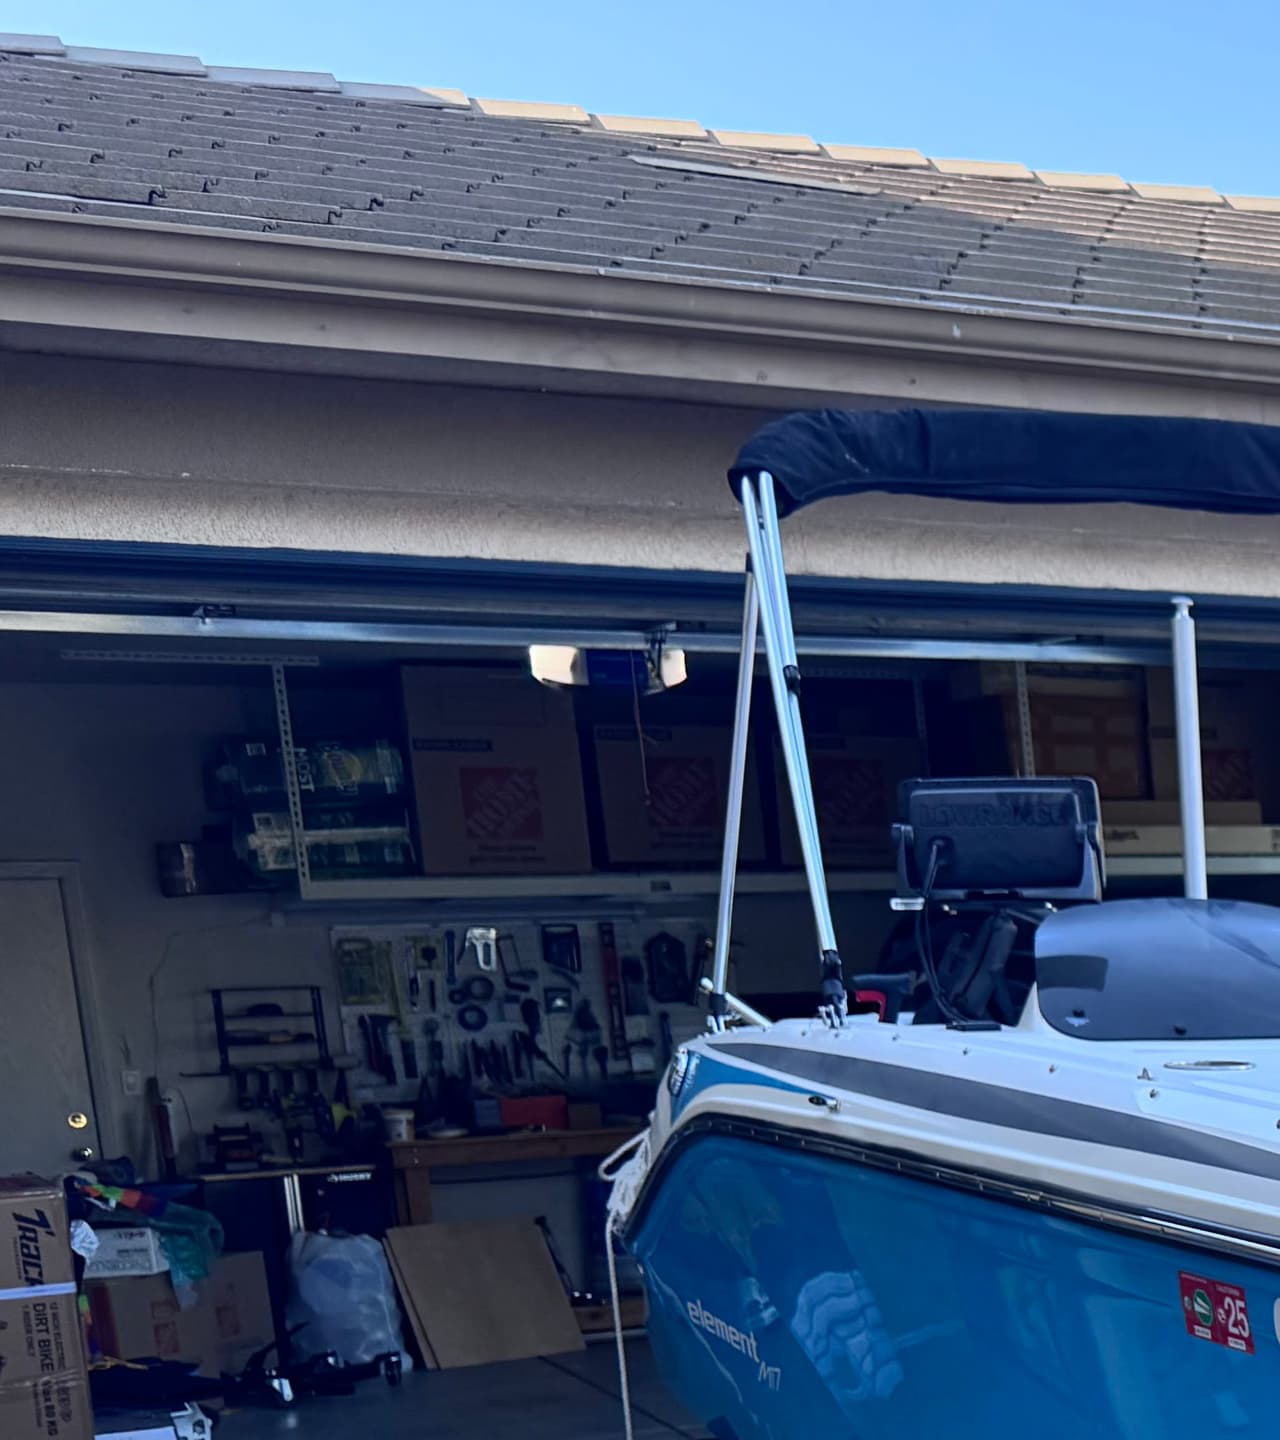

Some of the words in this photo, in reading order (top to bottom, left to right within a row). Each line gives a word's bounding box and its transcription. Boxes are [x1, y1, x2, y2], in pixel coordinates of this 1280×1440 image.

[33, 1303, 49, 1335] DIRT
[686, 1298, 760, 1363] element
[1224, 1296, 1250, 1338] 25
[38, 1339, 54, 1373] BIKE
